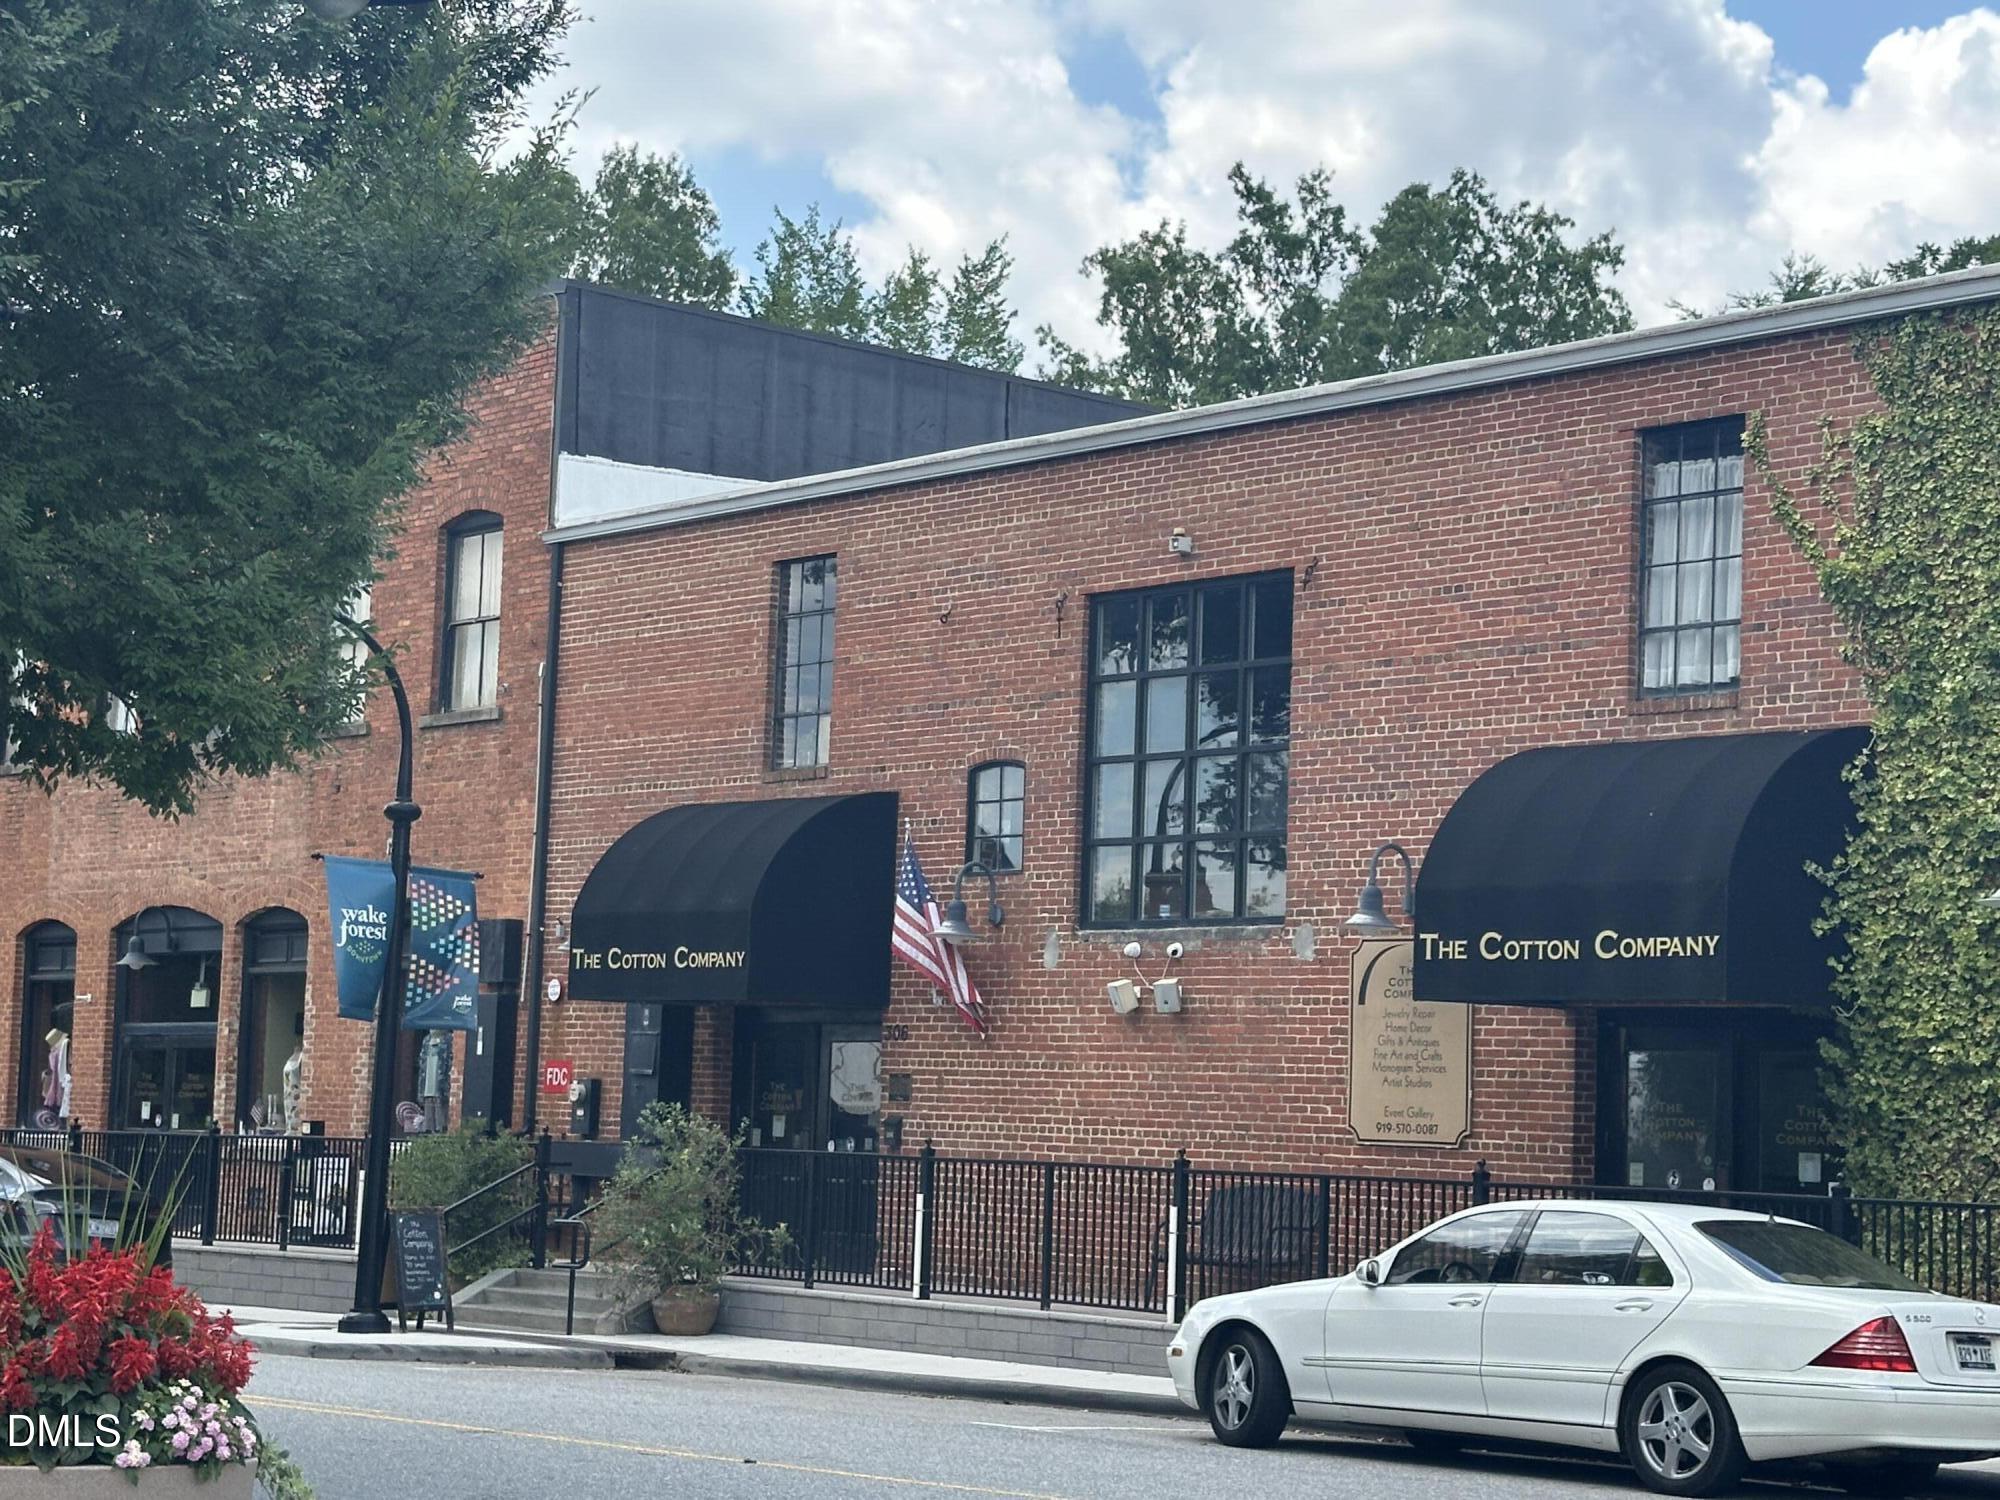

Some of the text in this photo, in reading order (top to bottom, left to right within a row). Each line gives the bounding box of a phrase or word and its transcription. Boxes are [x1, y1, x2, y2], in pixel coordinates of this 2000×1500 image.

[341, 904, 387, 924] wake
[336, 919, 387, 947] forest
[1419, 929, 1720, 960] THE COTTON COMPANY
[572, 946, 746, 970] THE COTTON COMPANY
[1399, 965, 1414, 975] TH
[1388, 977, 1413, 987] COT
[1383, 988, 1413, 999] COMP
[1382, 1006, 1436, 1019] Jewelry Repair
[1385, 1021, 1432, 1033] Home Decor
[1377, 1034, 1396, 1046] Gifts
[1406, 1034, 1440, 1048] Antiques
[1373, 1048, 1443, 1060] Fine Art and Crafts
[1372, 1060, 1447, 1075] Monogram Services
[546, 1067, 569, 1086] FDC
[1381, 1075, 1433, 1088] Artist Studios
[1384, 1105, 1434, 1120] Event Gallery
[1375, 1122, 1439, 1135] 919-570-0087
[403, 1229, 428, 1239] Cotton
[402, 1239, 434, 1253] Company
